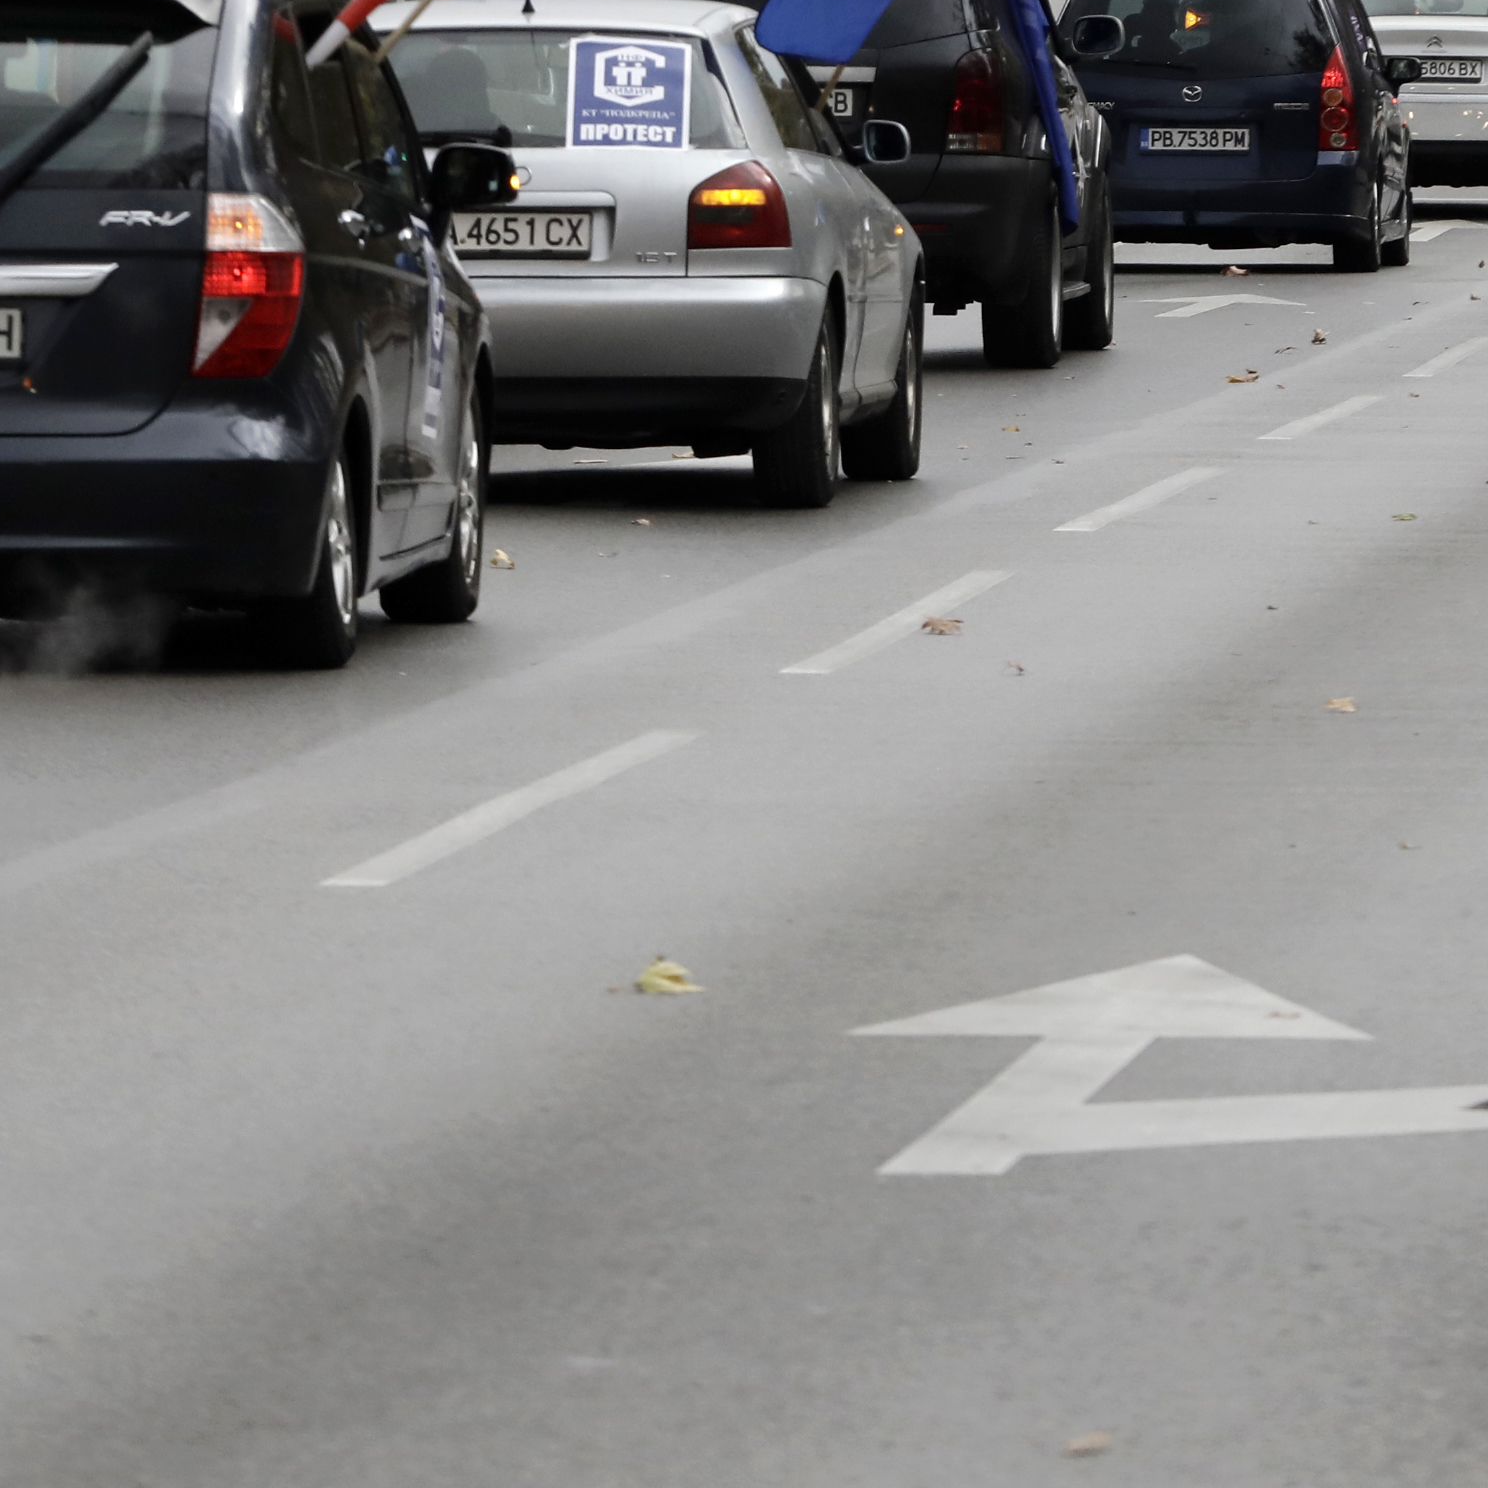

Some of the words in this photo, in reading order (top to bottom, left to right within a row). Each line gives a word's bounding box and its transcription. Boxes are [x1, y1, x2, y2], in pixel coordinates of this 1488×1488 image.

[1458, 61, 1479, 76] BX
[579, 123, 677, 143] ПРОТЕСТ
[1222, 129, 1247, 148] PM
[545, 216, 584, 247] CX
